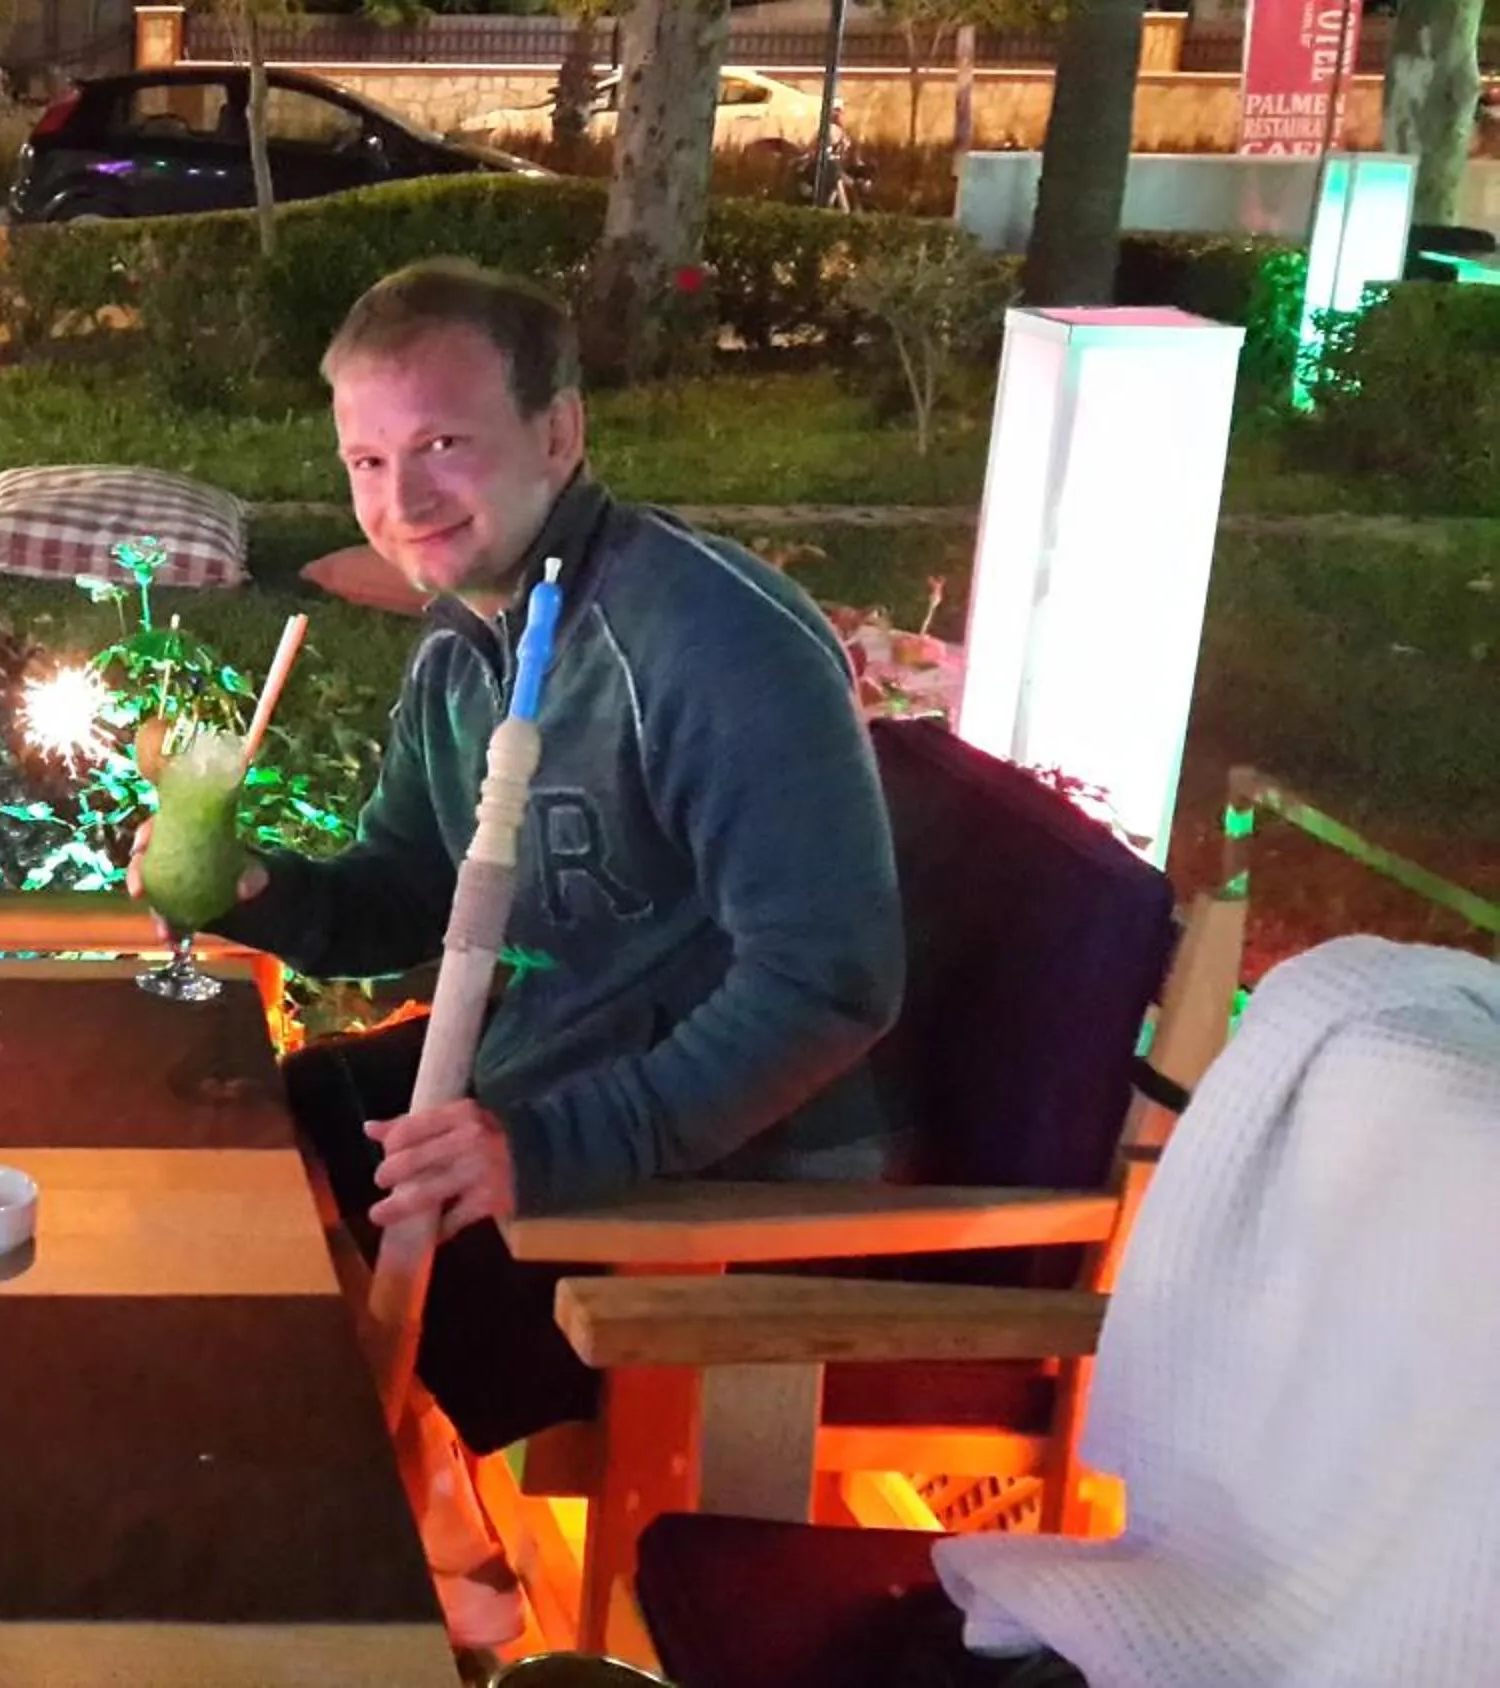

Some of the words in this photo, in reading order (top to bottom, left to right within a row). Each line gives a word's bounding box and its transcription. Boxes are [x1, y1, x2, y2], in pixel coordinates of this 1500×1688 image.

[1311, 10, 1355, 82] OTEL
[1246, 93, 1346, 115] PALMEN
[1243, 117, 1344, 139] RESTAURAT
[529, 786, 653, 928] R
